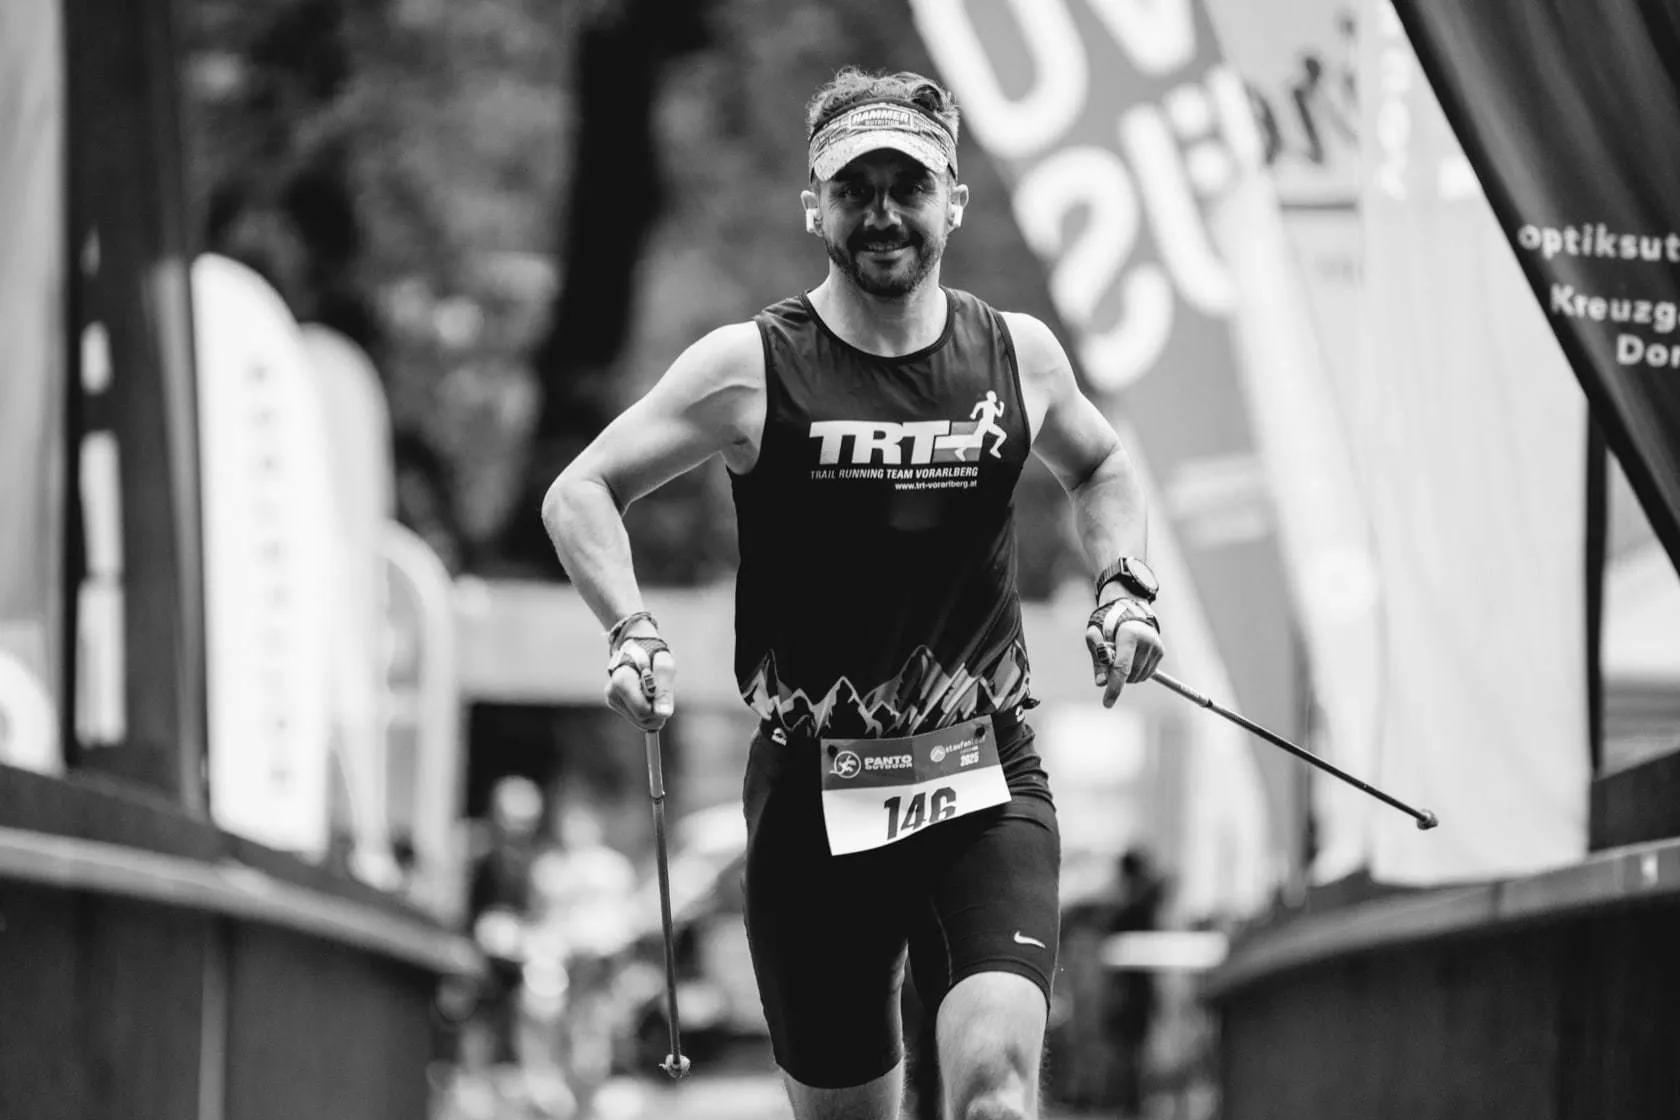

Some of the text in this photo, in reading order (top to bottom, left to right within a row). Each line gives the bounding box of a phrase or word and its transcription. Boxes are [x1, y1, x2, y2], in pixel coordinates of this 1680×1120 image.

[852, 110, 909, 124] HAMMER
[1551, 283, 1680, 333] Kreuzg
[809, 420, 950, 464] TRT
[811, 466, 978, 479] TRAIL RUNNING TEAM VORARLBERG
[895, 480, 977, 491] www.trt-vorarlberg.at
[864, 754, 913, 766] PANTO
